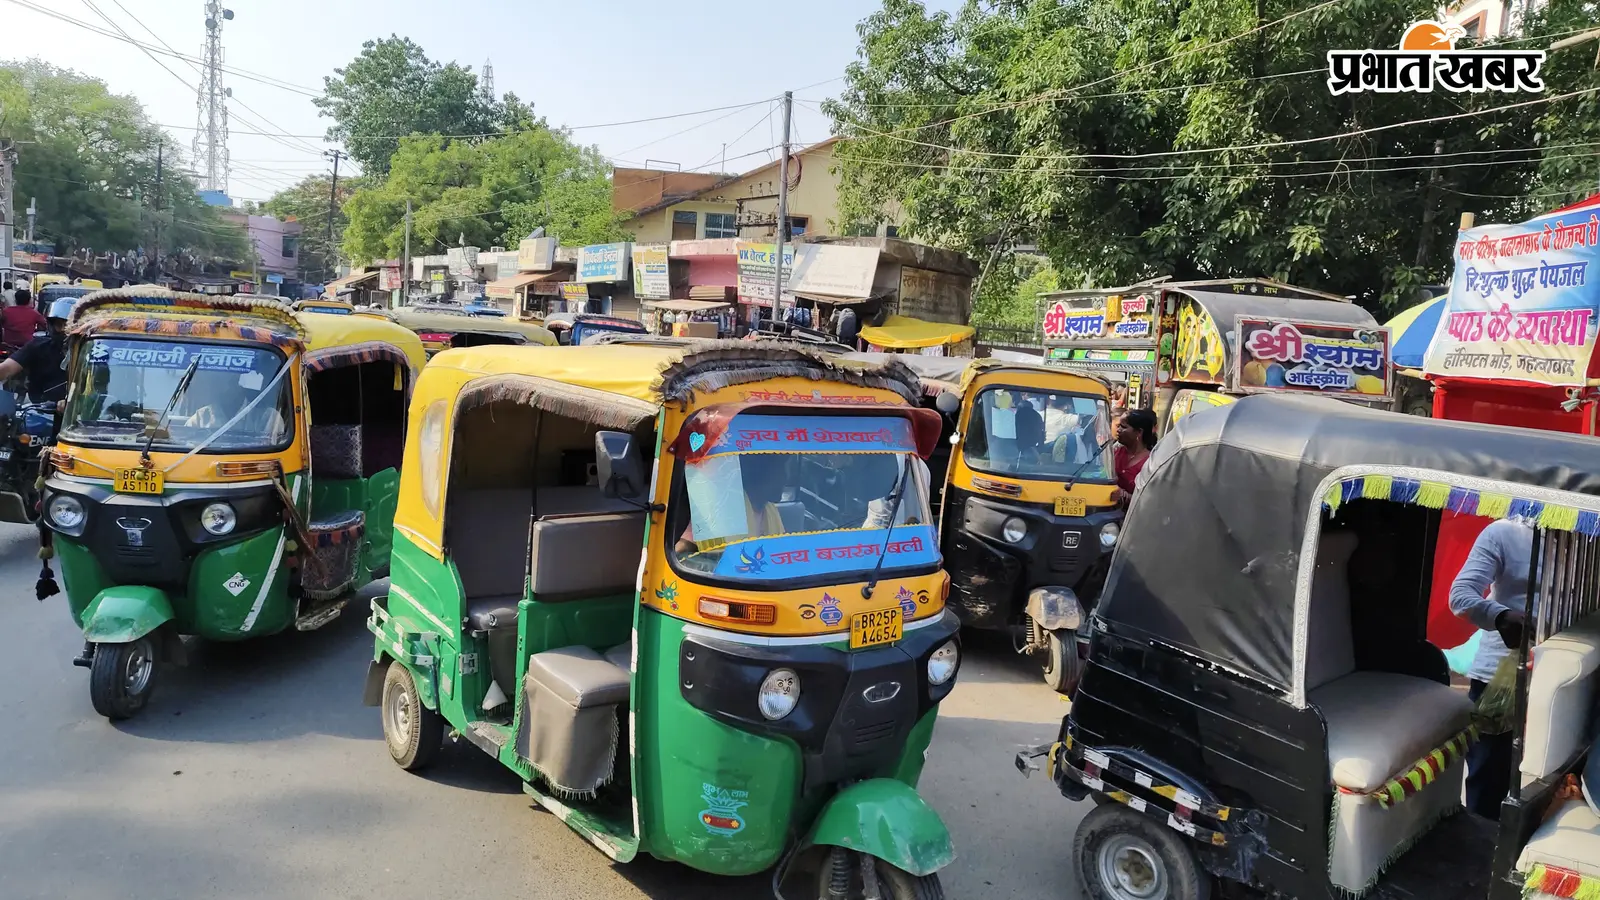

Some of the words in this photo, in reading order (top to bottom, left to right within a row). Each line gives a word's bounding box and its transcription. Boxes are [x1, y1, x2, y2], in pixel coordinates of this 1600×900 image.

[1460, 241, 1475, 260] नगर
[1500, 232, 1541, 257] जहानाबाद
[1542, 224, 1552, 251] के
[1554, 221, 1587, 250] सौजन्य
[1589, 214, 1599, 245] से
[740, 250, 748, 259] VK
[1512, 268, 1538, 299] शुद्ध
[1540, 260, 1588, 288] पेयजल
[1123, 297, 1146, 314] कुल्फी
[1044, 304, 1066, 334] श्री
[1065, 316, 1103, 336] श्याम
[1488, 303, 1513, 341] की
[1515, 310, 1592, 345] व्यवस्था
[112, 346, 187, 364] बालाजी
[1252, 326, 1302, 360] श्री
[1303, 342, 1381, 367] श्याम
[1443, 347, 1489, 369] हॉस्पिटल
[738, 429, 780, 442] जय
[123, 470, 157, 480] BR5P
[122, 481, 157, 492] A5110
[1065, 536, 1078, 545] RE
[770, 550, 810, 565] जय
[815, 543, 881, 560] बजरंग
[887, 536, 924, 554] बली
[862, 610, 897, 629] BR25P
[862, 625, 897, 645] A4654
